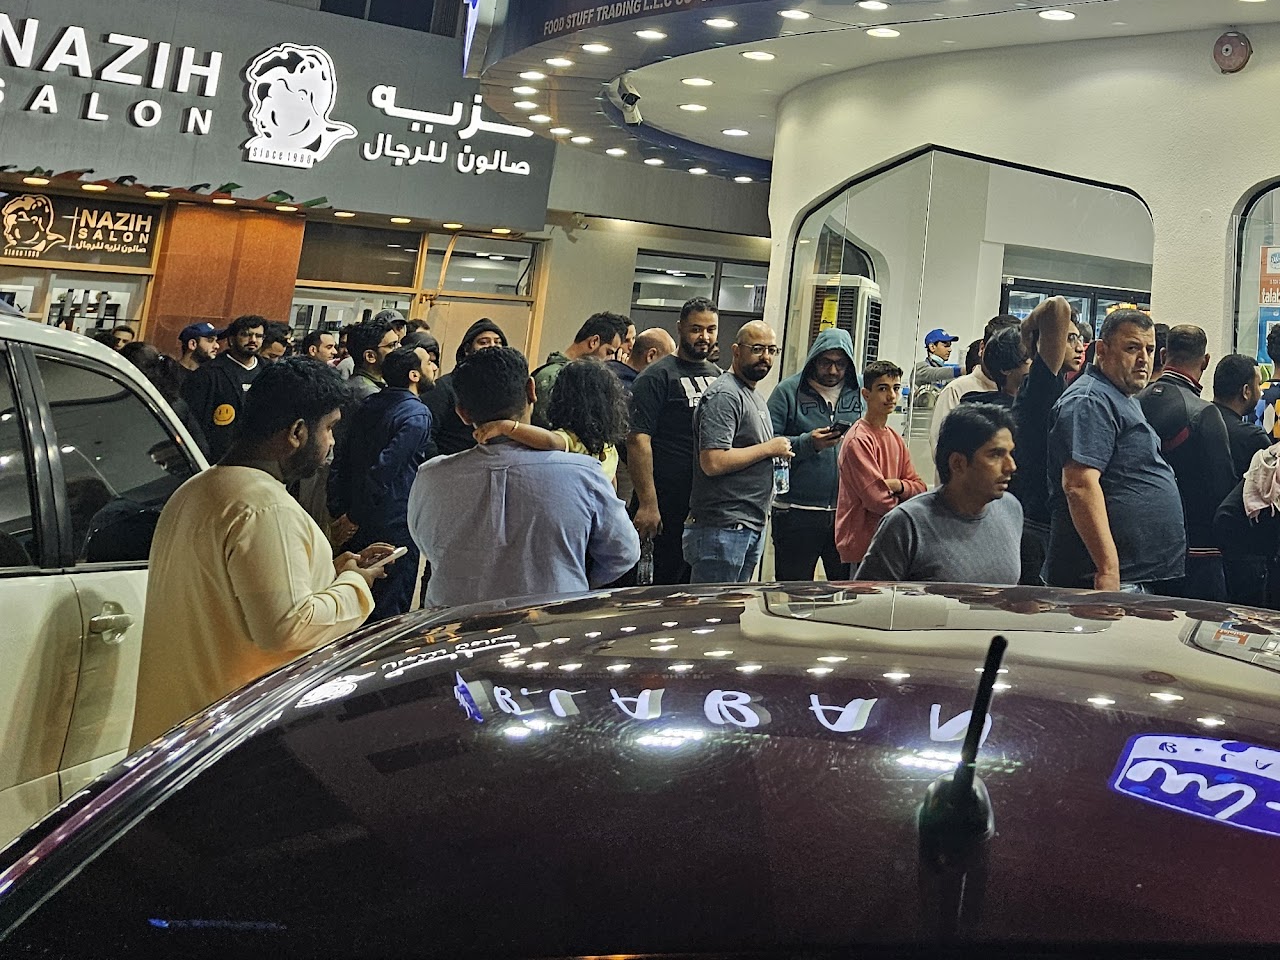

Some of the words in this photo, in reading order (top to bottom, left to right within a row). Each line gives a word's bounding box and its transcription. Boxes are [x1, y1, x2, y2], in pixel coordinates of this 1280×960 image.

[543, 17, 565, 36] FOOD
[566, 8, 595, 30] STUFF
[0, 12, 223, 97] NAZIH
[0, 76, 213, 135] ALON
[371, 84, 535, 139] زيه
[363, 132, 448, 166] للرجال
[456, 144, 531, 176] صالون
[77, 227, 149, 244] SALON
[79, 209, 152, 233] NAZIH
